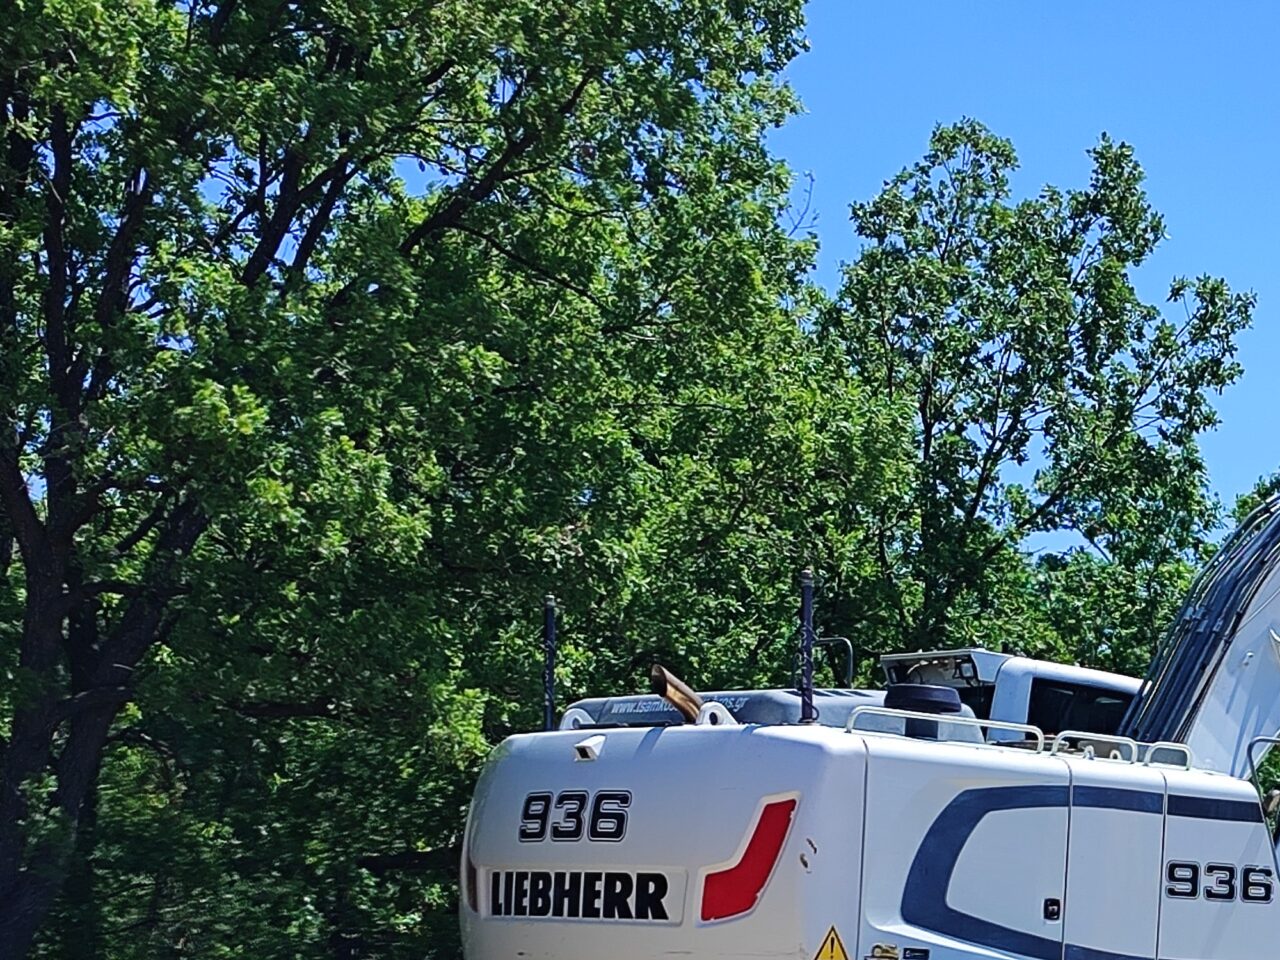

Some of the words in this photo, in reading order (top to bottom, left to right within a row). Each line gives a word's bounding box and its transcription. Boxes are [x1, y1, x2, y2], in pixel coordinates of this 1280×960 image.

[519, 790, 633, 843] 936
[492, 871, 669, 921] LIEBHERR
[1165, 859, 1276, 904] 936
